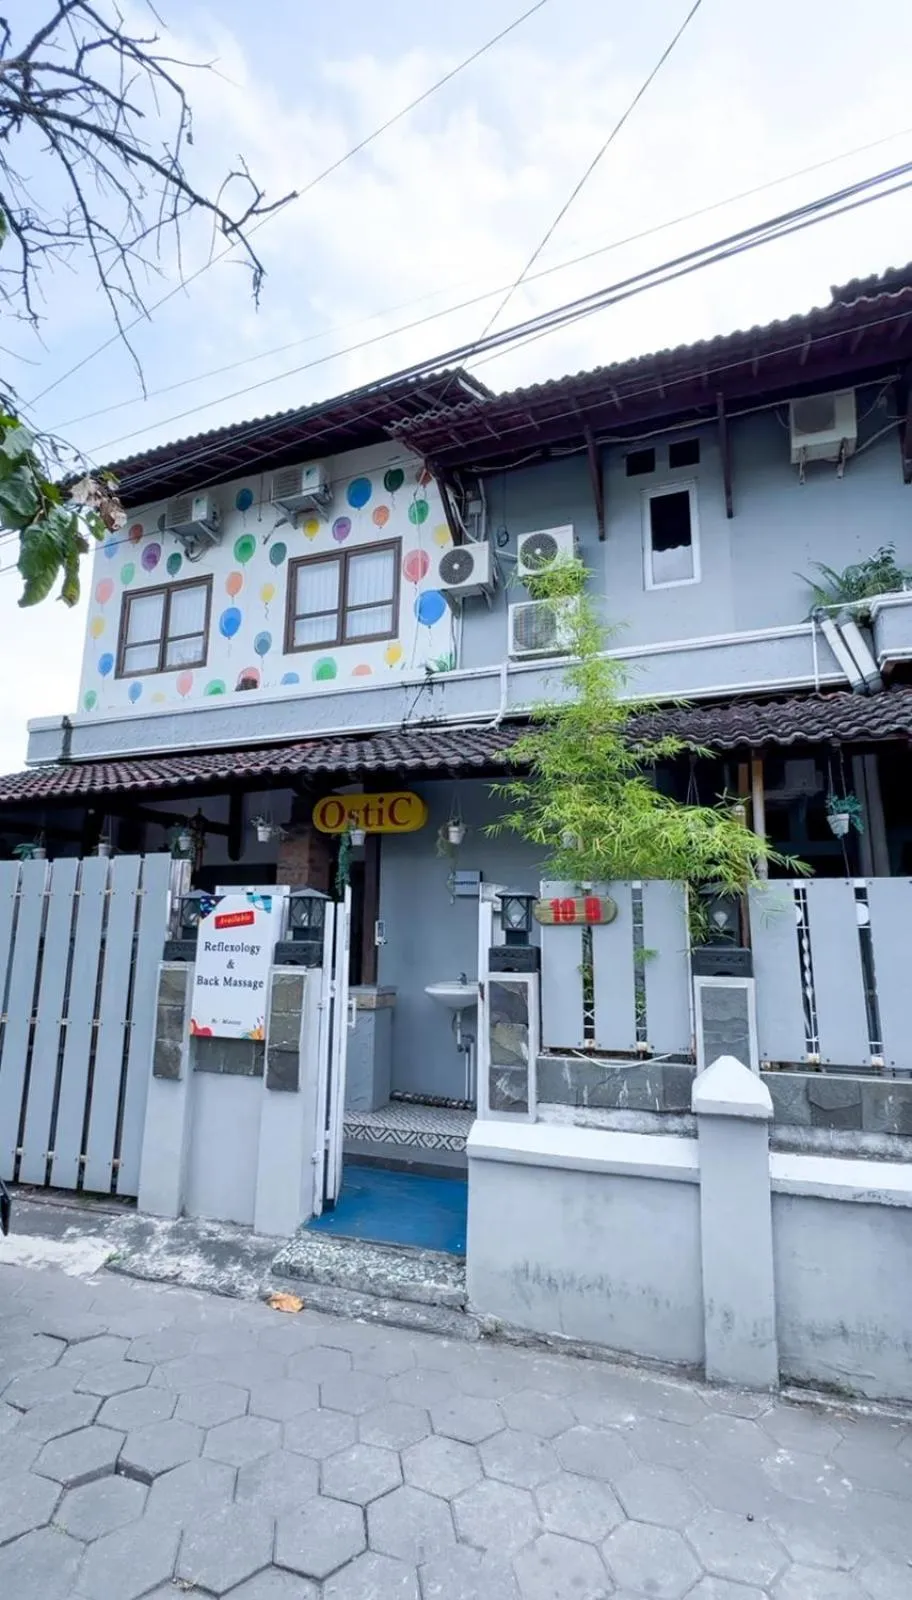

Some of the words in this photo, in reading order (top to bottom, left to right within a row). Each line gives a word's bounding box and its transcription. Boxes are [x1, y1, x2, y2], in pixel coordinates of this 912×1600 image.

[320, 797, 412, 828] OstiC
[550, 898, 576, 922] 10
[204, 941, 261, 955] Reflexology
[226, 959, 235, 969] &
[197, 976, 220, 986] Back
[223, 977, 264, 990] Massage
